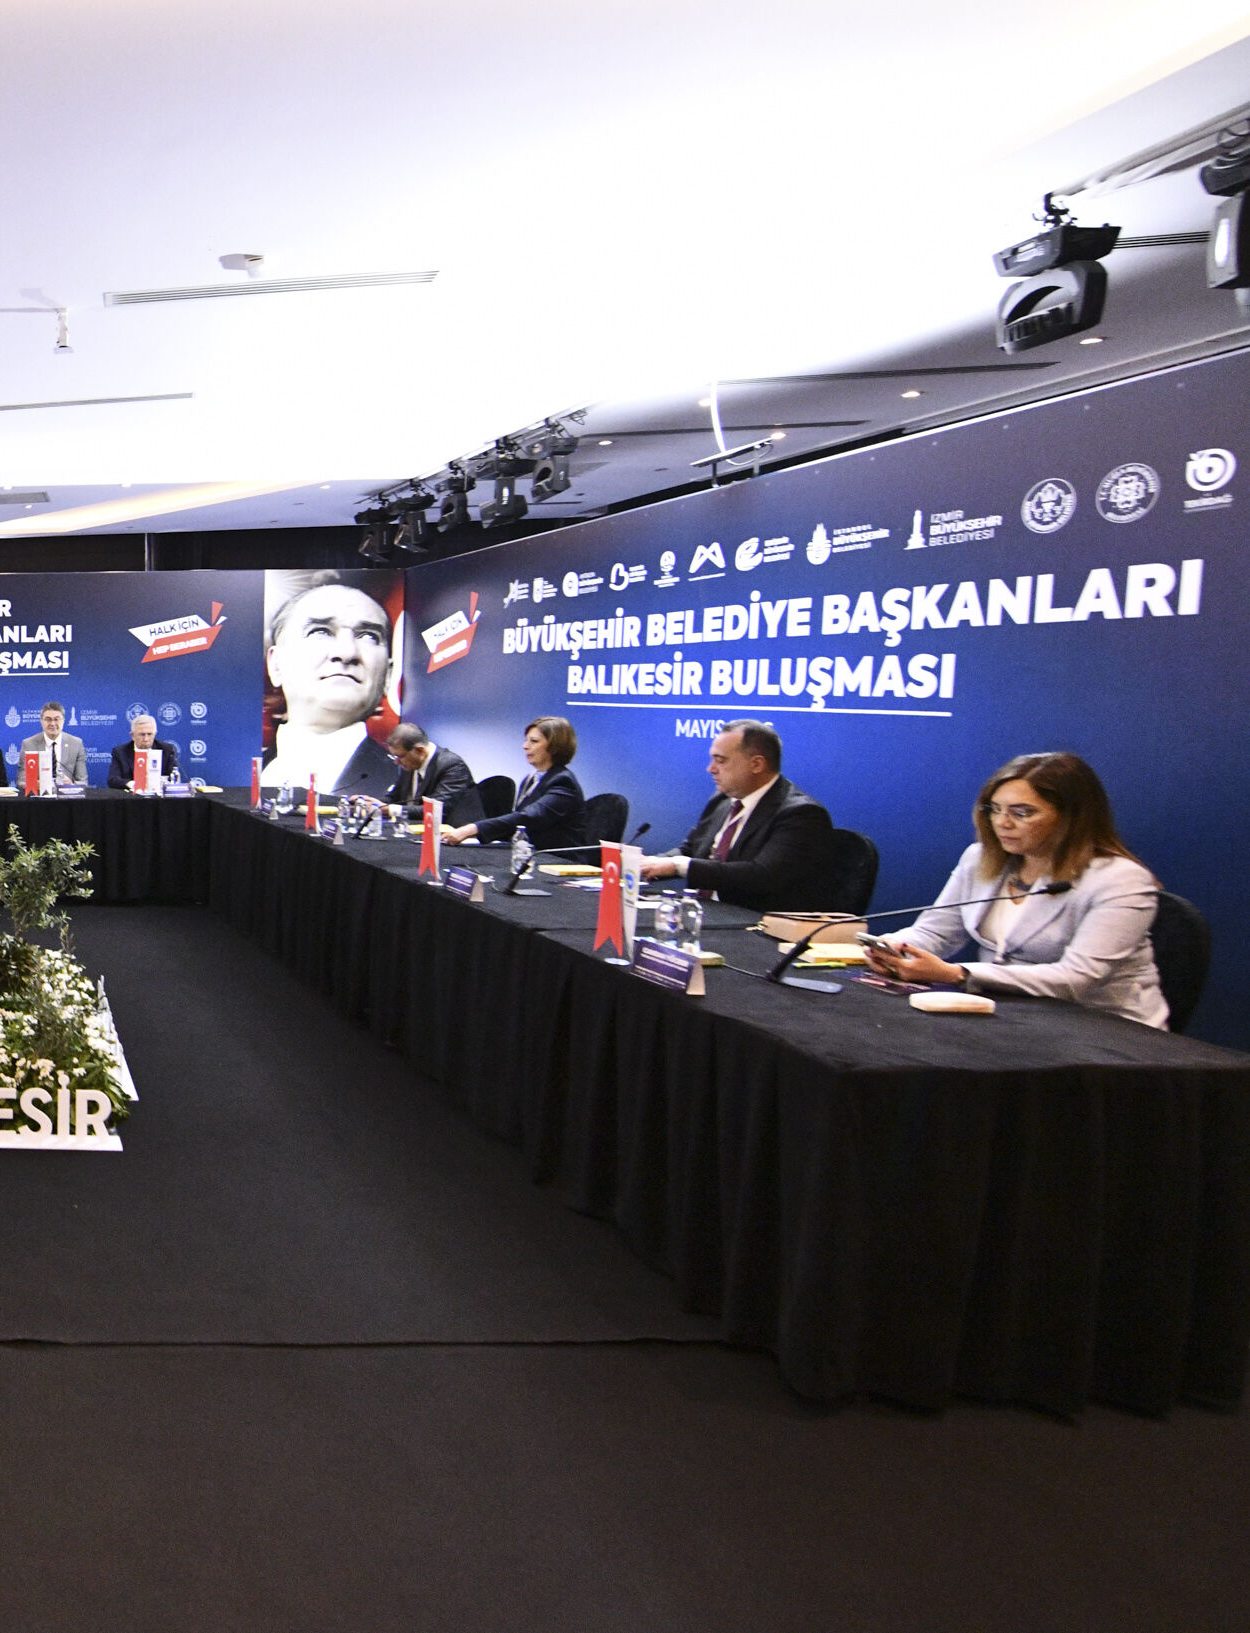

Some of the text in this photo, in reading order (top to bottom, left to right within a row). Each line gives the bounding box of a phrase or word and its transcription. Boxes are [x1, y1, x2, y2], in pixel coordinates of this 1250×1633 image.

[149, 617, 200, 637] HALK İÇİN
[502, 606, 642, 660] BÜYÜKŞEHİR
[646, 590, 812, 646] BELEDİYE
[821, 558, 1204, 648] BAŞKANLARI
[566, 651, 956, 709] BALIKESİR BULUŞMASI
[675, 718, 724, 738] MAYIS
